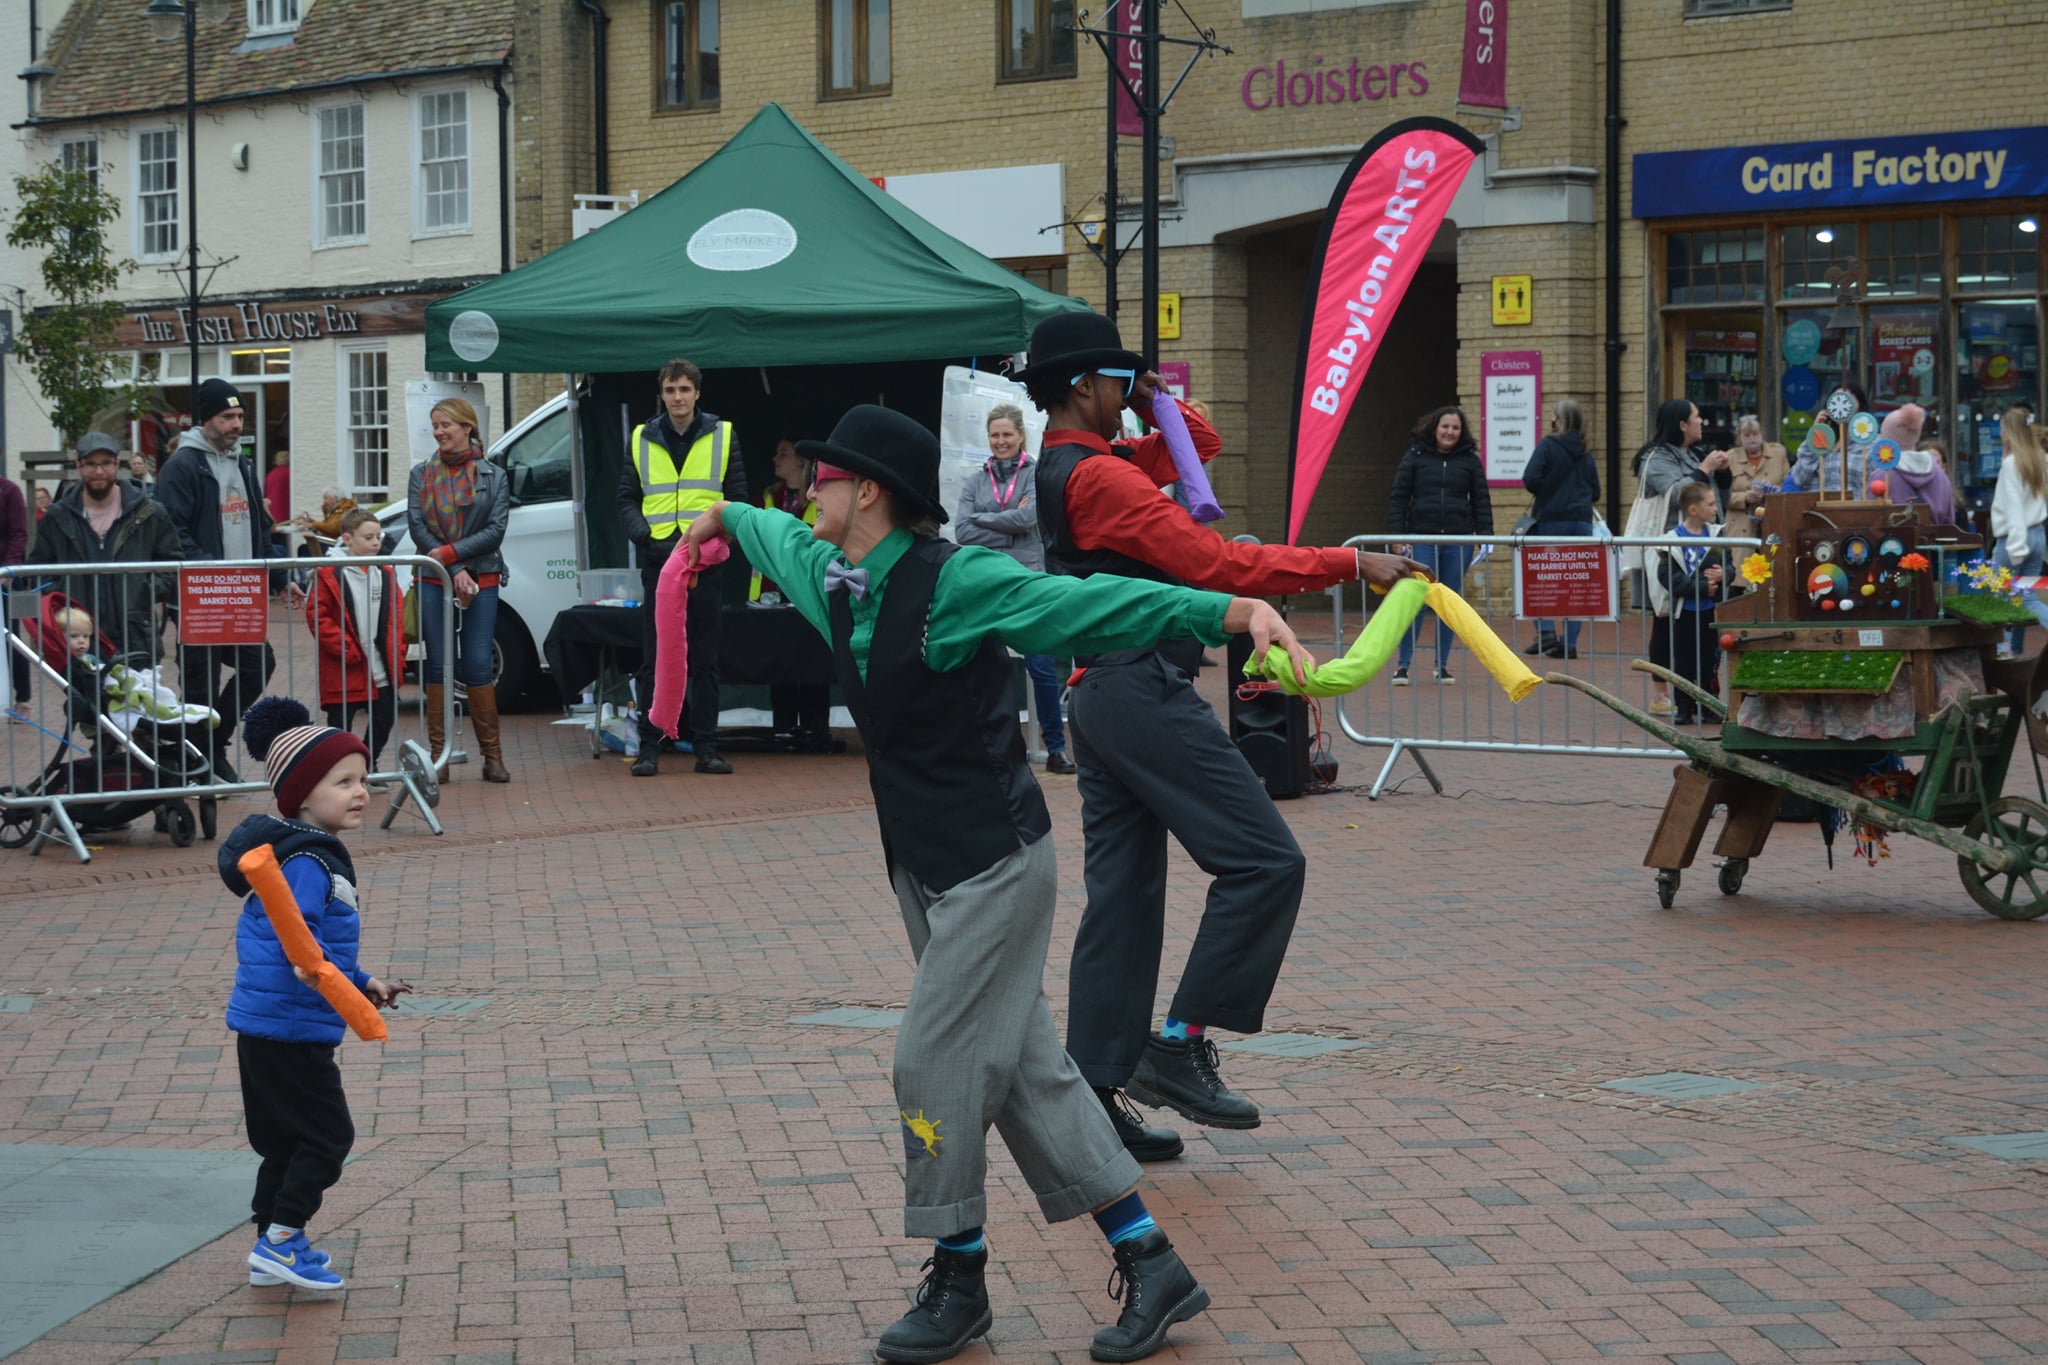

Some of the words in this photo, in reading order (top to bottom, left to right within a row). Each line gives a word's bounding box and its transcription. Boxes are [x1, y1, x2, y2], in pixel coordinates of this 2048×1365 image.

[1241, 55, 1429, 110] Cloisters
[1742, 152, 1832, 194] Card
[1853, 146, 2007, 189] Factory
[693, 238, 719, 249] ELY
[724, 236, 793, 248] MARKETS
[1491, 360, 1530, 370] Cloisters
[1528, 552, 1549, 560] PLEASE
[1550, 552, 1560, 560] DO
[1561, 552, 1577, 560] NOT
[1578, 551, 1598, 559] MOVE
[1568, 562, 1586, 570] UNTIL
[188, 575, 212, 583] PLEASE
[214, 575, 225, 583] DO
[227, 575, 241, 583] NOT
[242, 575, 261, 583] MOVE
[188, 586, 203, 594] THIS
[204, 586, 232, 594] BARRIER
[233, 586, 250, 594] UNTIL
[250, 586, 261, 594] THE
[200, 597, 227, 605] MARKET
[228, 597, 253, 605] CLOSES
